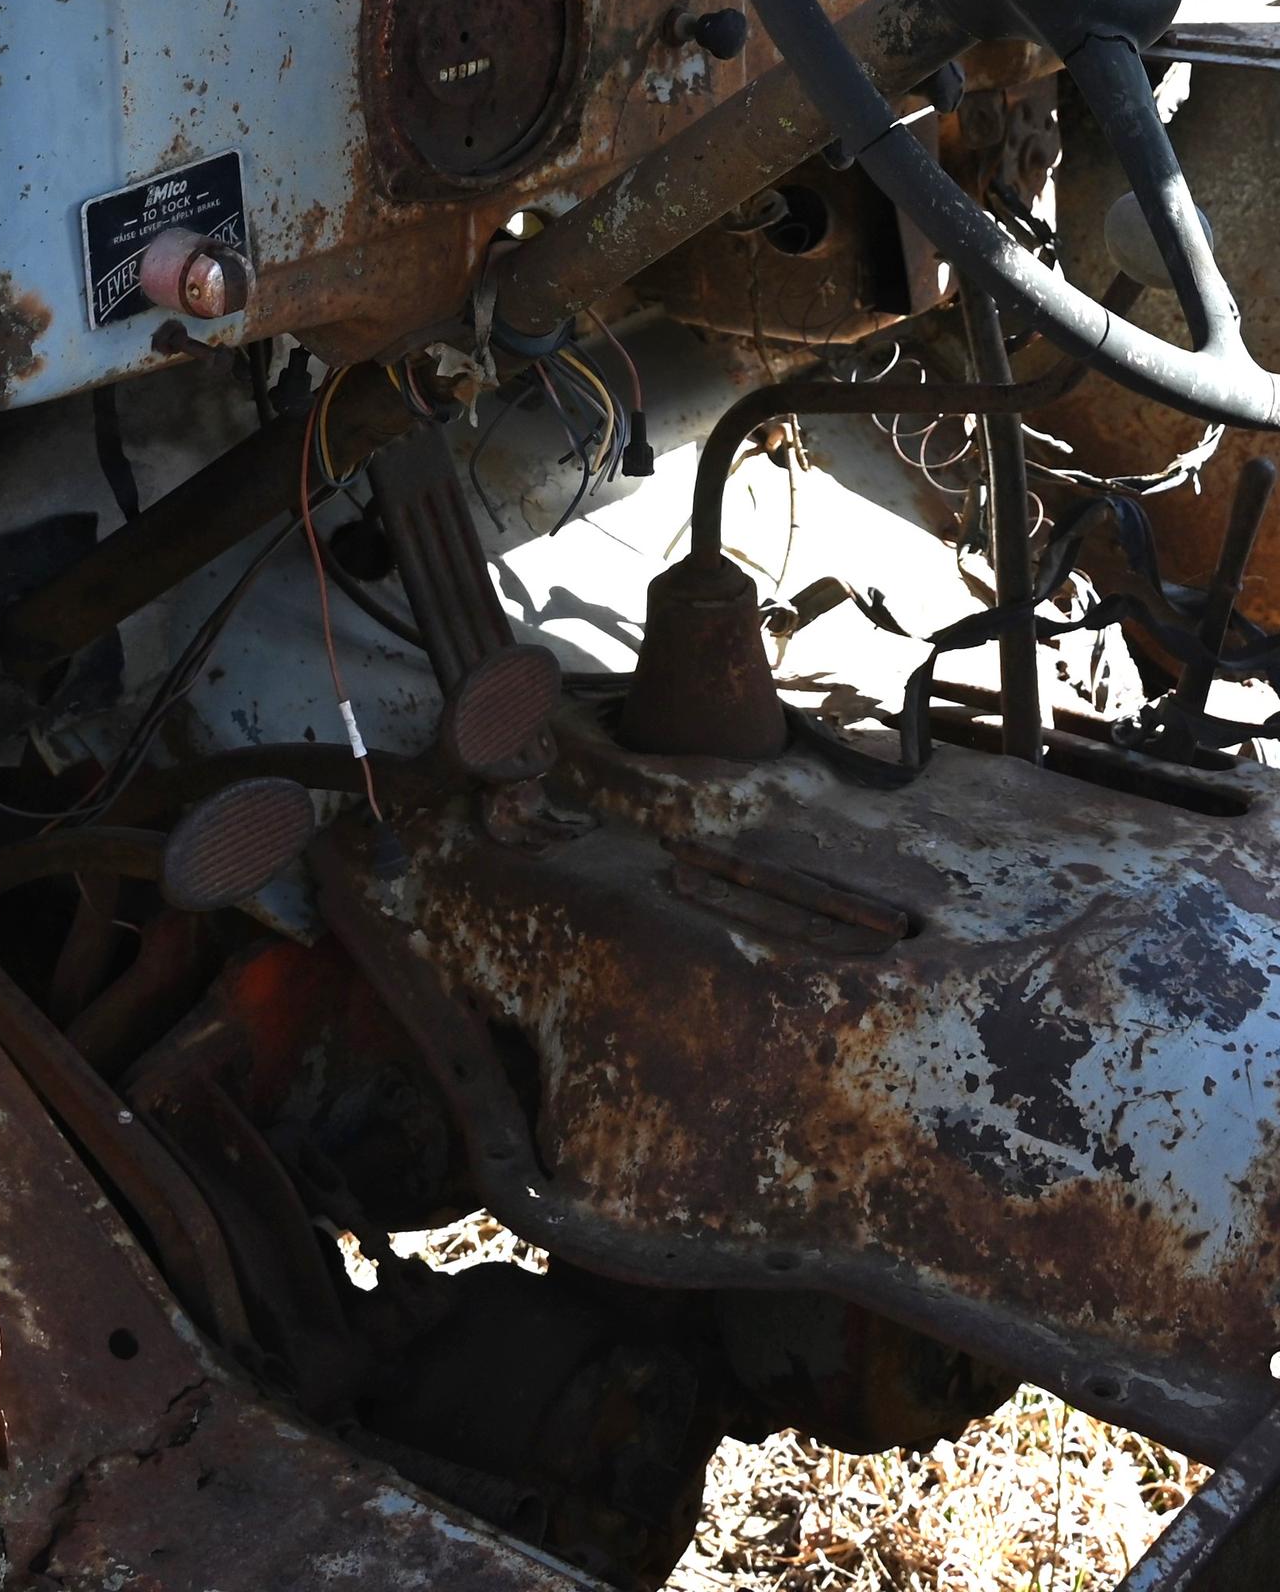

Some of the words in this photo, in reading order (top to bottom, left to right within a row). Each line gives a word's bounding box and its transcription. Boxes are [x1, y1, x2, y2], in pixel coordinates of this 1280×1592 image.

[113, 231, 136, 244] RAISE
[197, 198, 221, 213] BRAKE
[142, 208, 157, 223] TO
[162, 194, 191, 215] LOCK
[214, 219, 239, 245] OCK
[98, 259, 140, 313] LEVER
